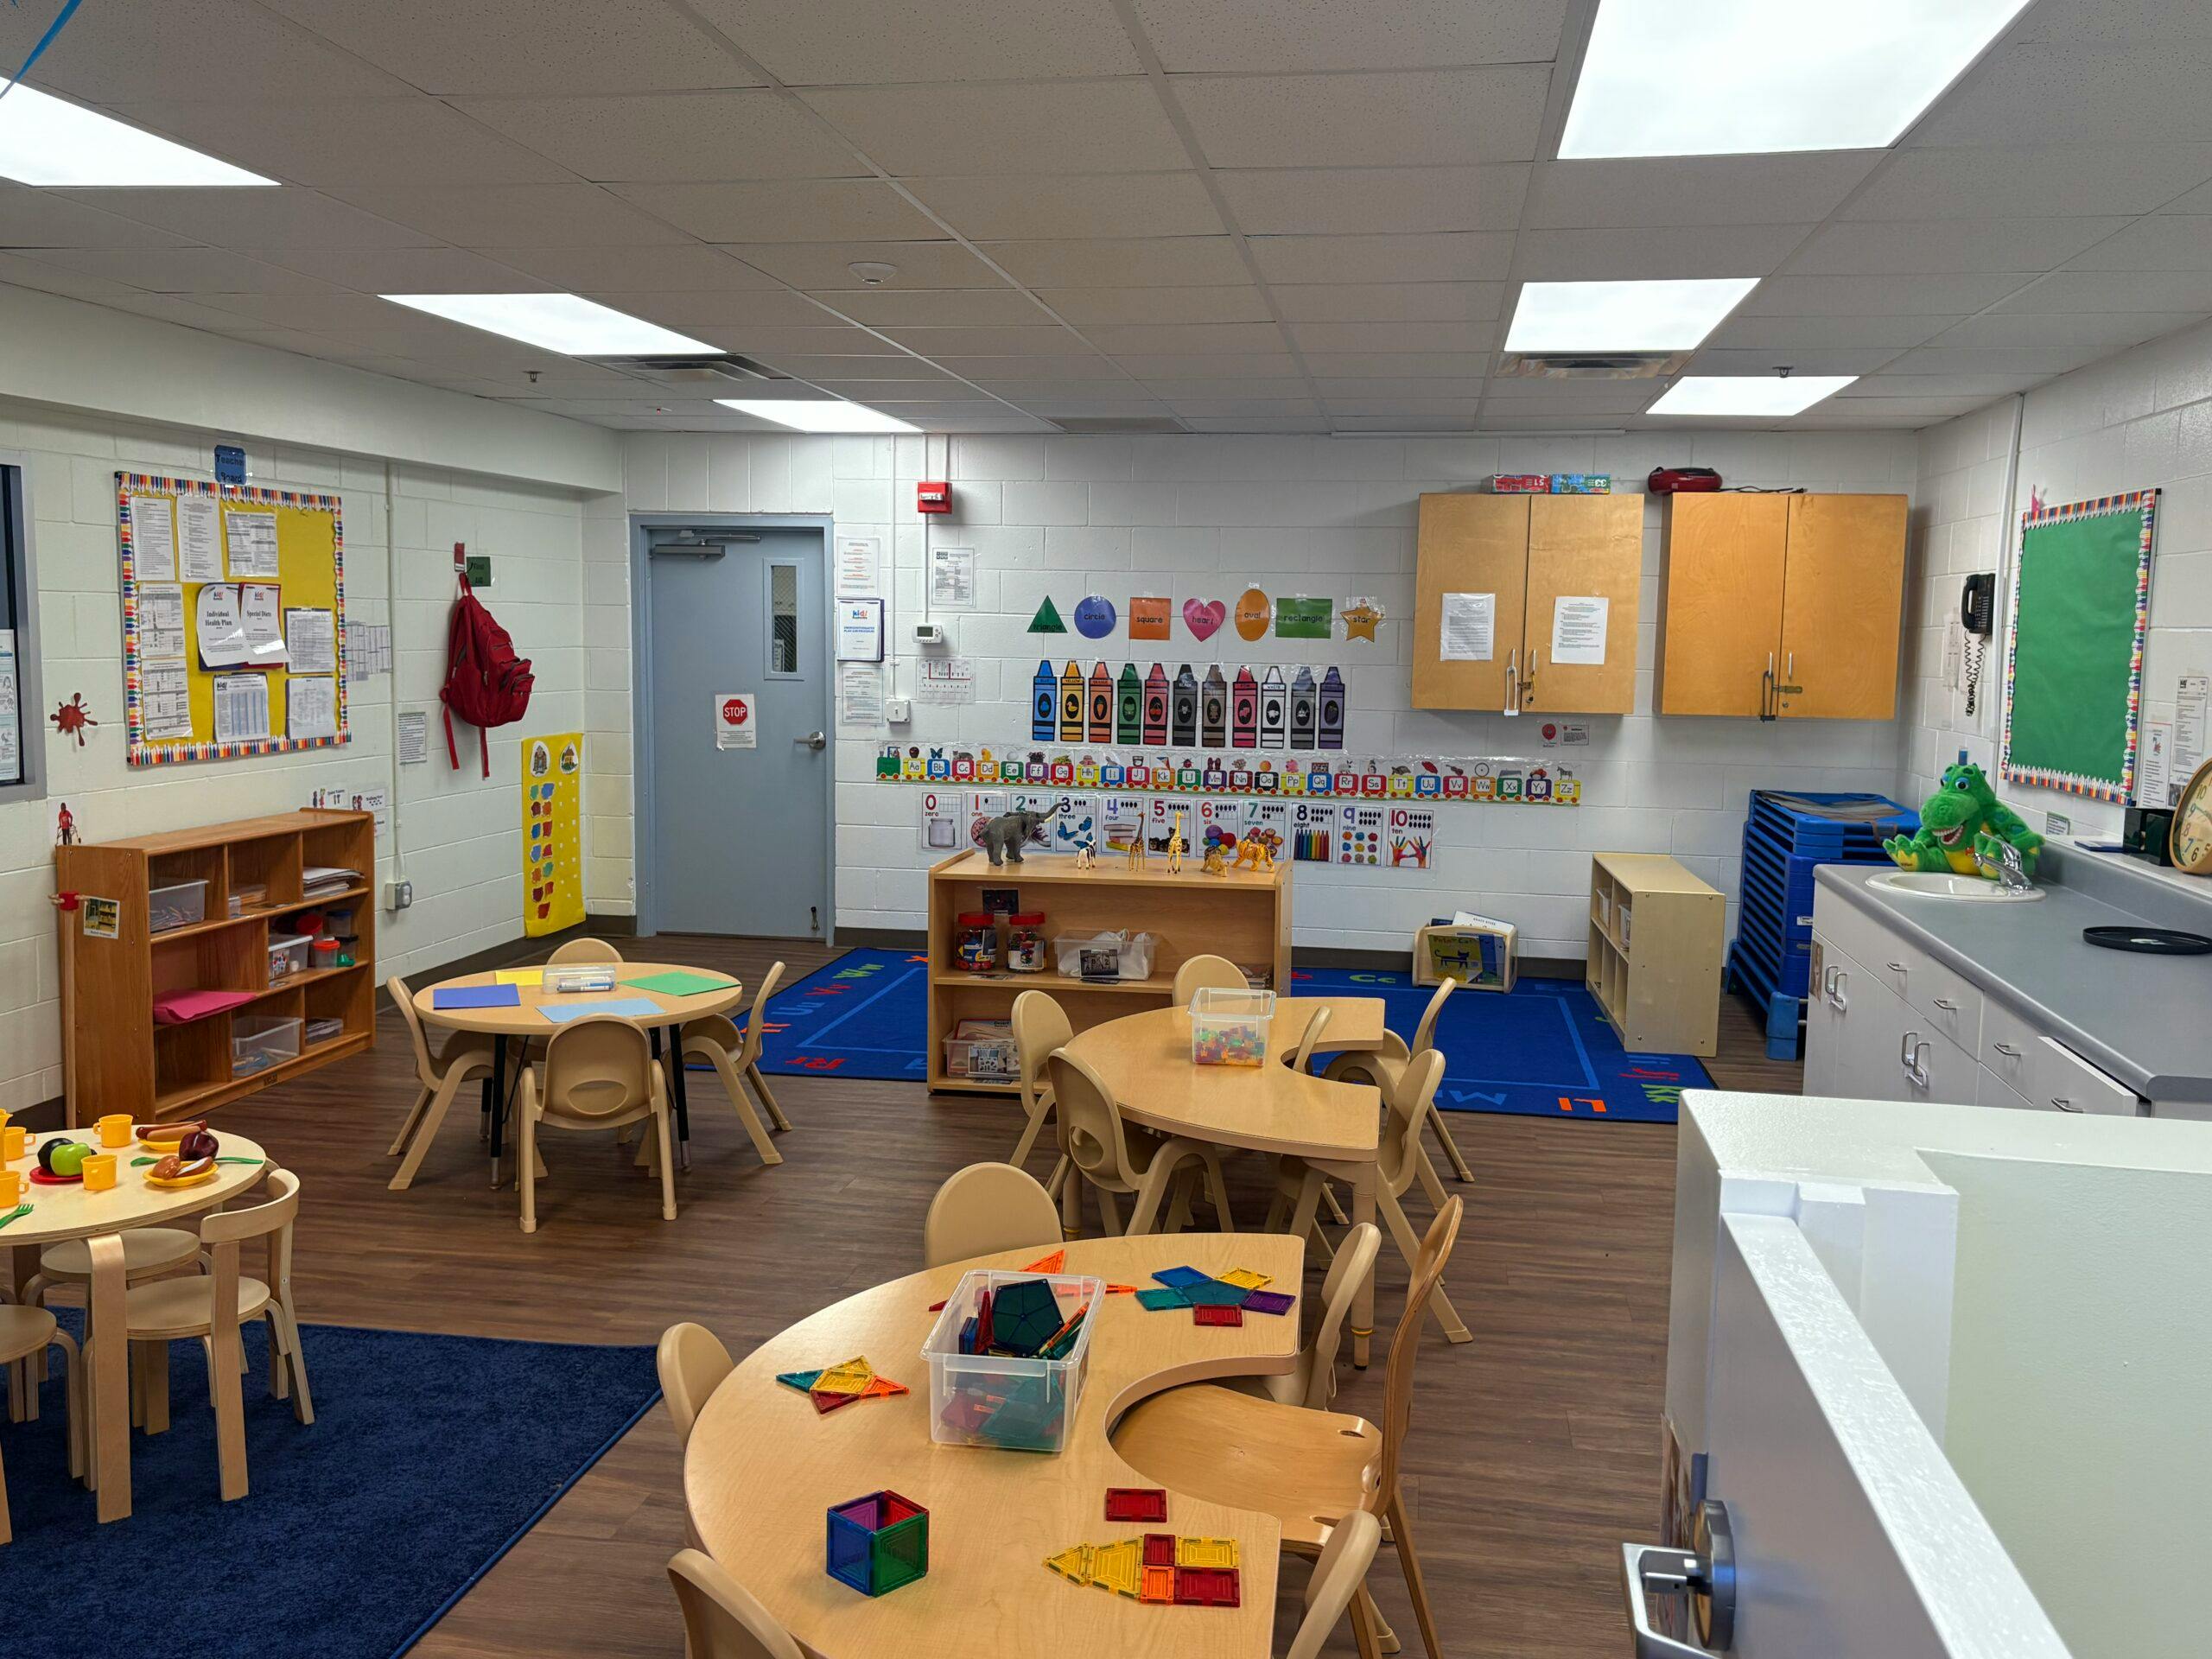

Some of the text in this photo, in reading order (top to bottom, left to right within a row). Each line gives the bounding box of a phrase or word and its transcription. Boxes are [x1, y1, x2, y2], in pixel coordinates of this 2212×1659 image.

[1594, 479, 1607, 487] 33
[1084, 612, 1105, 620] circle
[1136, 616, 1163, 625] square
[1192, 616, 1213, 625] heart
[1243, 611, 1261, 620] oval
[1283, 614, 1324, 623] rectangle
[1353, 615, 1370, 624] star
[1033, 623, 1063, 632] triangle
[724, 707, 747, 717] STOP
[910, 762, 919, 771] Aa
[1032, 766, 1041, 775] Ff
[1058, 767, 1068, 777] Gg
[1134, 770, 1143, 779] Jj
[1236, 774, 1246, 783] Nn
[1261, 775, 1271, 784] Oo
[1287, 776, 1298, 785] Pp
[1314, 777, 1325, 787] Qq
[1341, 777, 1351, 785] Rr
[1396, 779, 1406, 787] Tt
[1477, 781, 1490, 790] Ww
[1506, 782, 1516, 791] Xx
[1533, 783, 1544, 793] Yy
[1560, 785, 1573, 793] Zz
[2196, 784, 2207, 800] 10
[925, 795, 937, 810] 0
[976, 795, 979, 810] 1
[1015, 796, 1027, 810] 2
[1061, 797, 1071, 812] 3
[1107, 798, 1118, 814] 4
[1154, 801, 1165, 816] 5
[1201, 802, 1212, 817] 6
[1249, 803, 1258, 817] 7
[1297, 805, 1307, 820] 8
[1344, 808, 1355, 823] 9
[2188, 803, 2196, 817] 9
[1391, 810, 1408, 826] 10
[2183, 822, 2191, 836] 8
[2184, 838, 2194, 853] 7
[2191, 847, 2199, 862] 6
[1349, 974, 1396, 983] Cc
